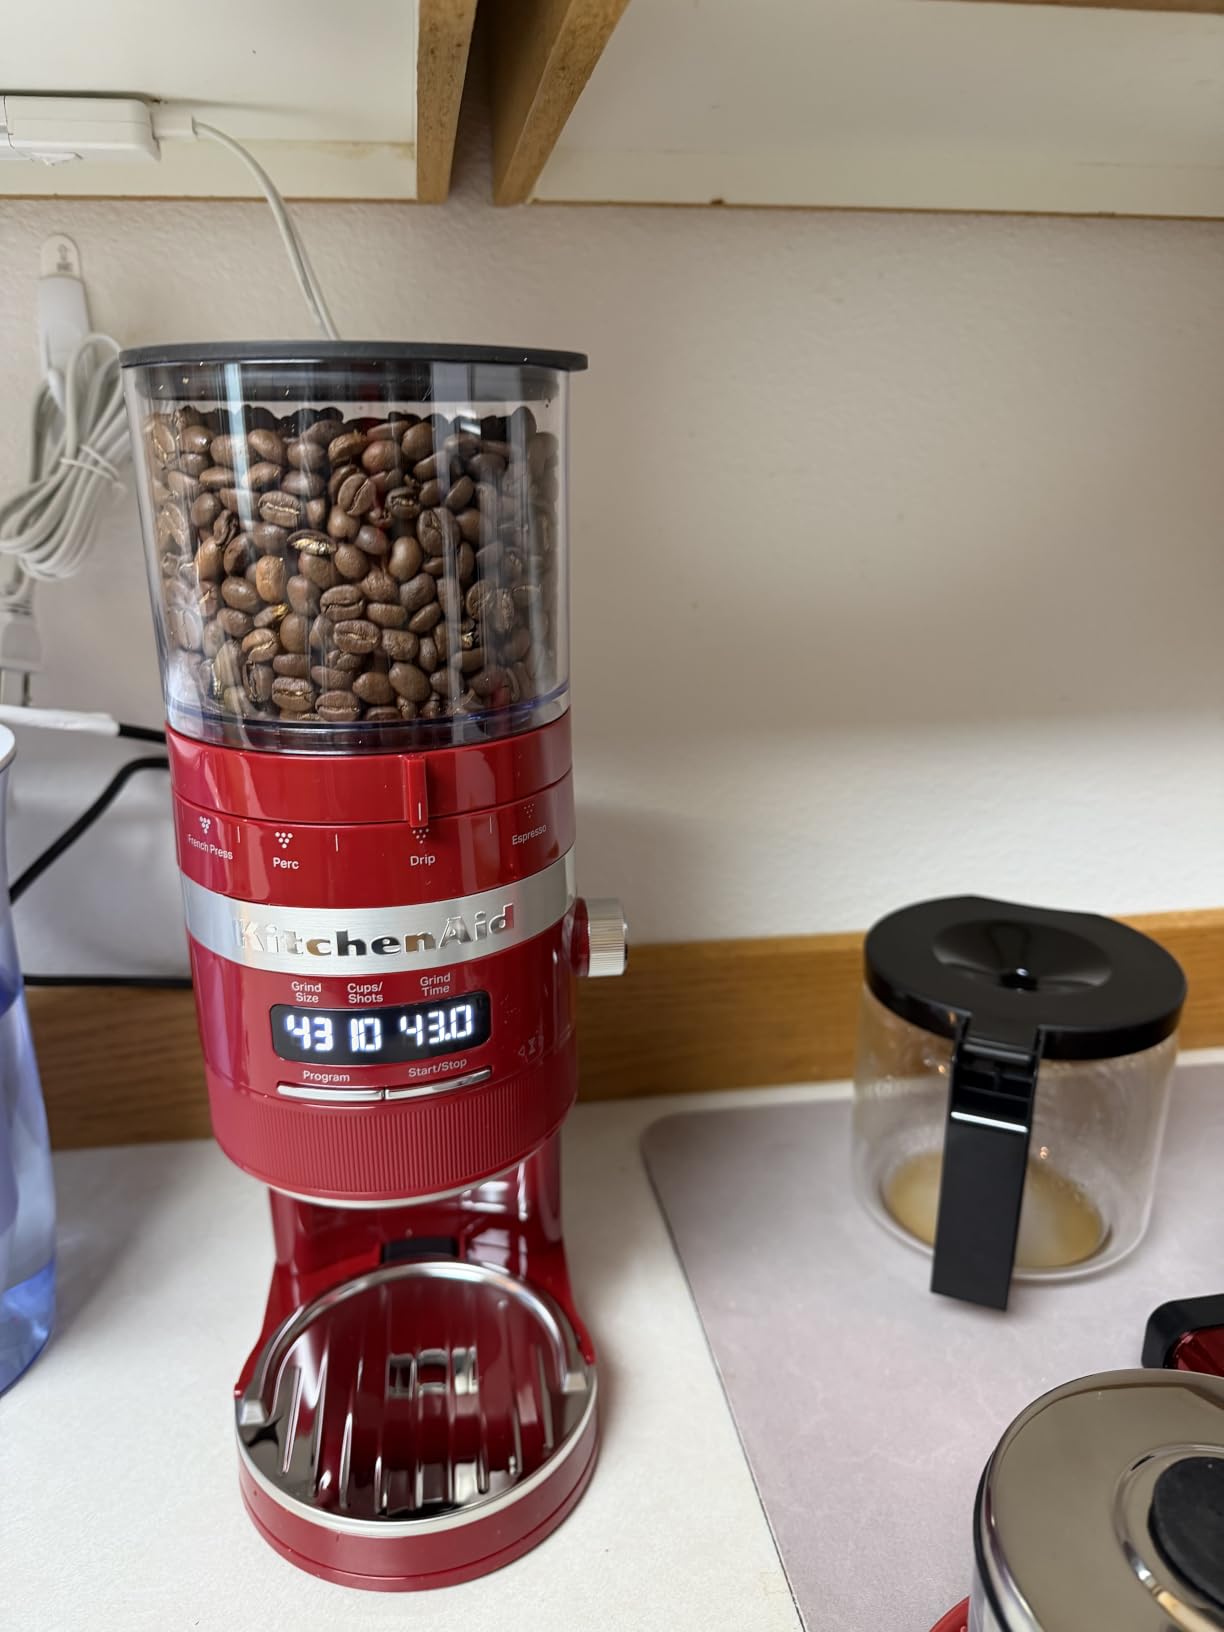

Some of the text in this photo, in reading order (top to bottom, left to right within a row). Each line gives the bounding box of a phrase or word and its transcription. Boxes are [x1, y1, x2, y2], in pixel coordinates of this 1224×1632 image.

[511, 824, 547, 846] Espresso
[188, 834, 233, 860] French Press
[273, 856, 300, 870] Perc
[410, 854, 436, 866] Drip
[233, 903, 514, 957] KitchenAid
[420, 973, 450, 987] Grind
[291, 981, 321, 993] Grind
[347, 981, 383, 994] Cups/
[422, 984, 449, 997] Time
[295, 992, 319, 1003] Size
[348, 993, 384, 1004] Shots
[286, 1004, 473, 1051] 43 10 43.0
[408, 1058, 467, 1078] Start/Stop
[303, 1070, 350, 1083] Program
